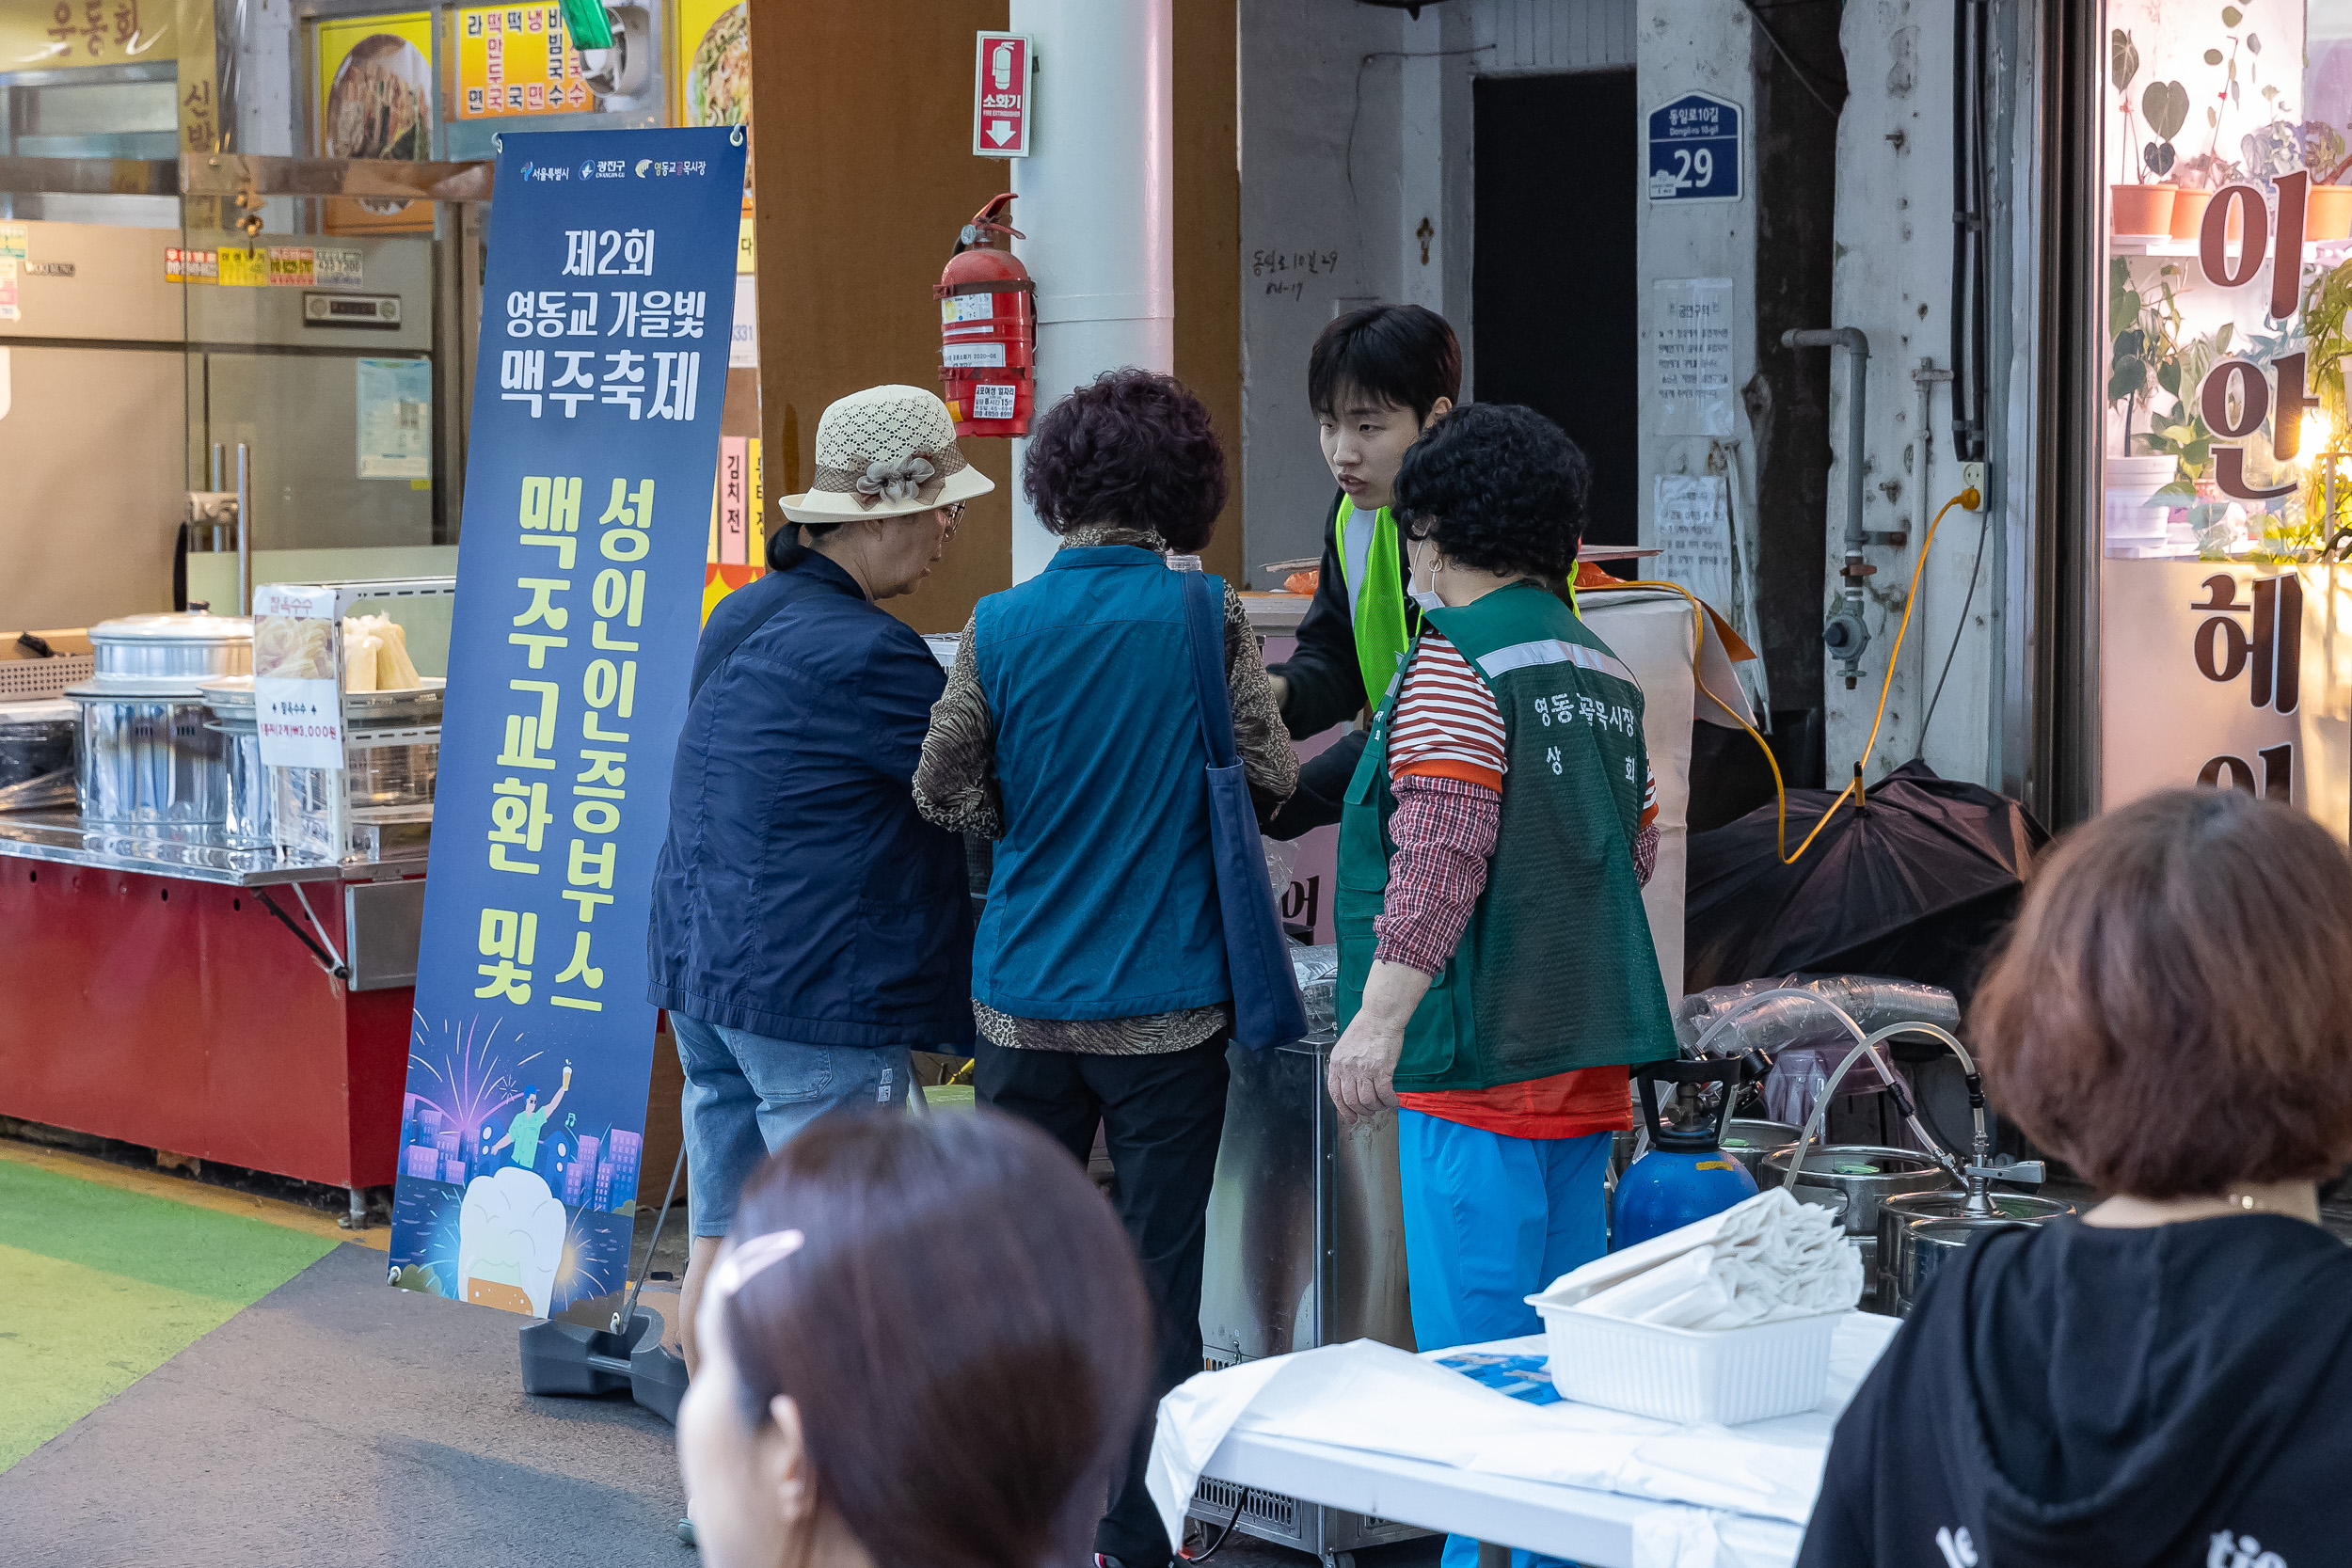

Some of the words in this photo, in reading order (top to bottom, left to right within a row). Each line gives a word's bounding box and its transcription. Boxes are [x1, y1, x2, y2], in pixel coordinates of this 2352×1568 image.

[486, 12, 503, 111] 떡만두국
[548, 8, 563, 105] 비빔국수
[983, 94, 1021, 109] 소화기
[1669, 107, 1719, 125] 동일로10길
[532, 167, 569, 182] 서울특별시
[596, 161, 626, 172] 광진구
[654, 161, 707, 177] 영동교골목시장
[1675, 148, 1713, 188] 29
[562, 228, 656, 277] 제2회
[506, 291, 598, 338] 영동교
[607, 291, 707, 338] 가을빛
[2199, 168, 2320, 501] 이안
[501, 349, 700, 421] 맥주축제
[727, 455, 740, 503] 김치
[271, 596, 312, 615] 찰옥수수
[487, 476, 583, 875] 맥주교환
[550, 478, 656, 1012] 성인인증부스
[474, 908, 538, 1006] 및
